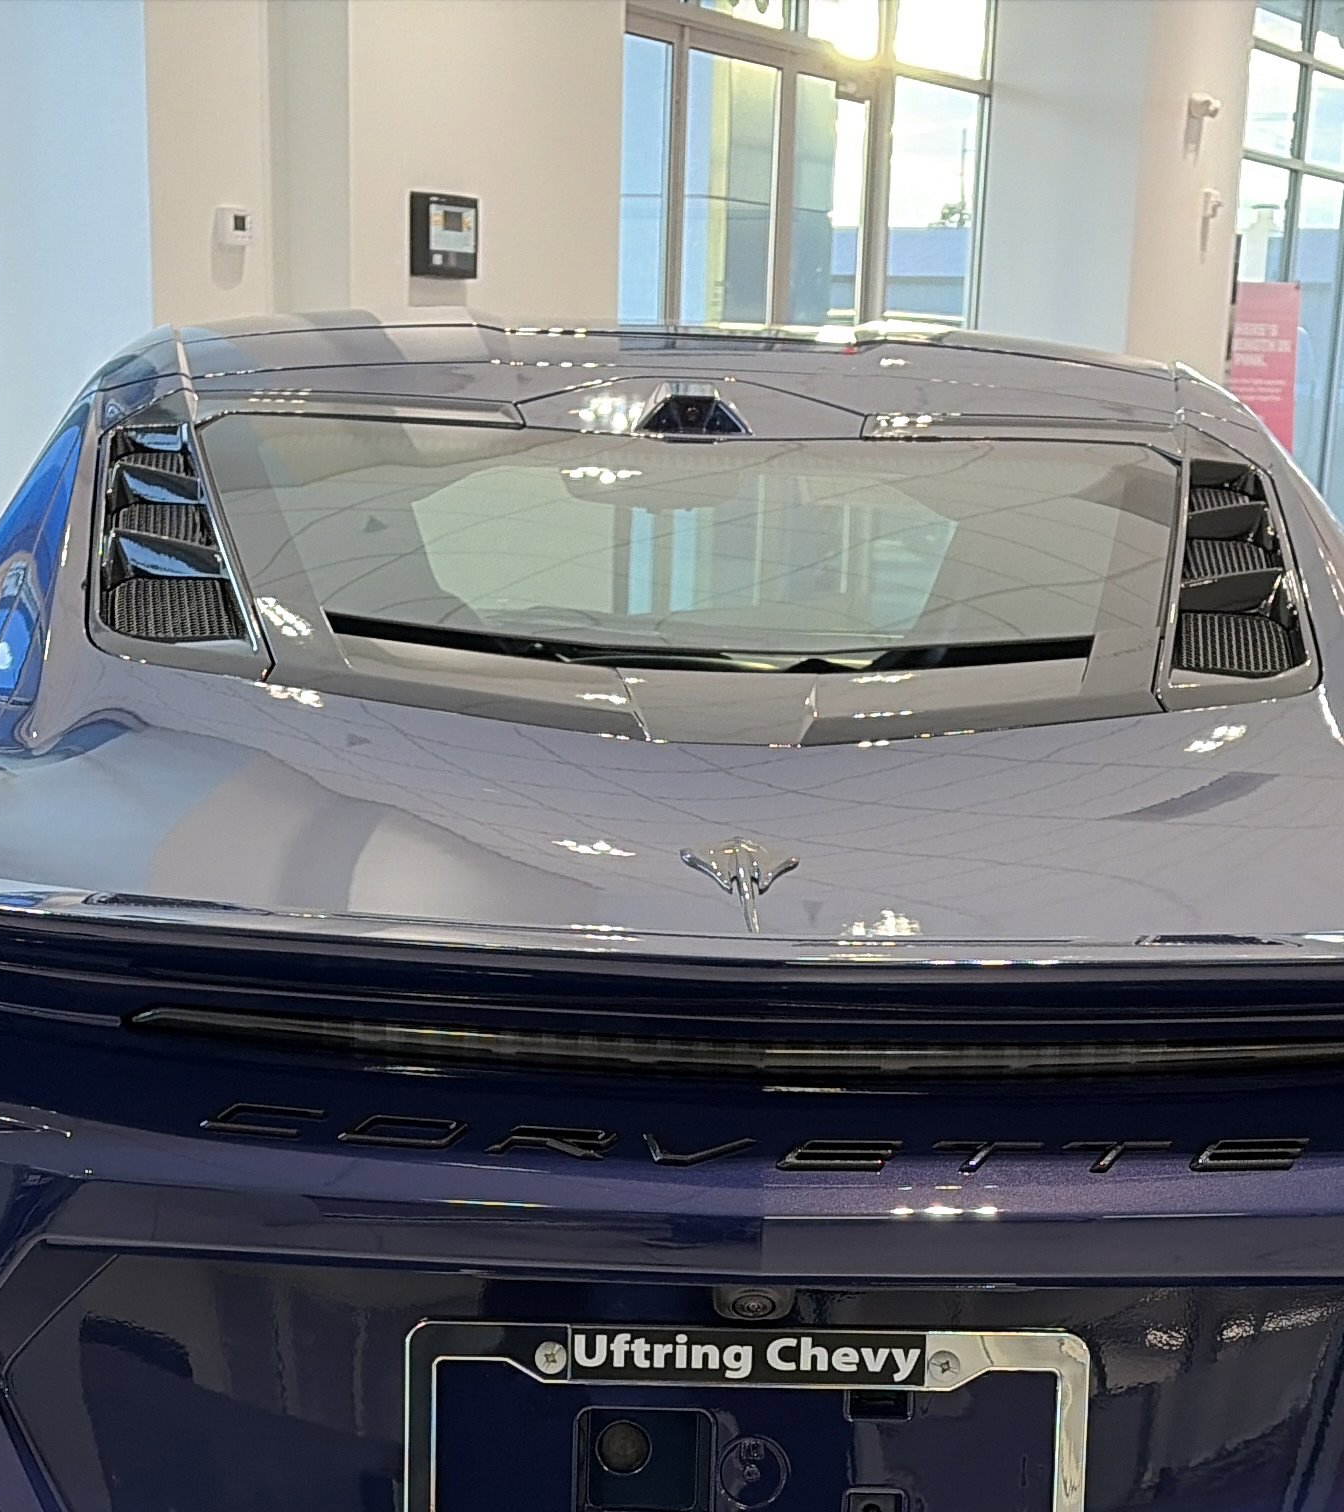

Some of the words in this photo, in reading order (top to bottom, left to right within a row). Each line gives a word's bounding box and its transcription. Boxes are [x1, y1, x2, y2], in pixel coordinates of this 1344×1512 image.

[200, 1102, 1311, 1172] CORVETTE
[573, 1333, 754, 1379] Uftring
[765, 1336, 921, 1382] Chevy
